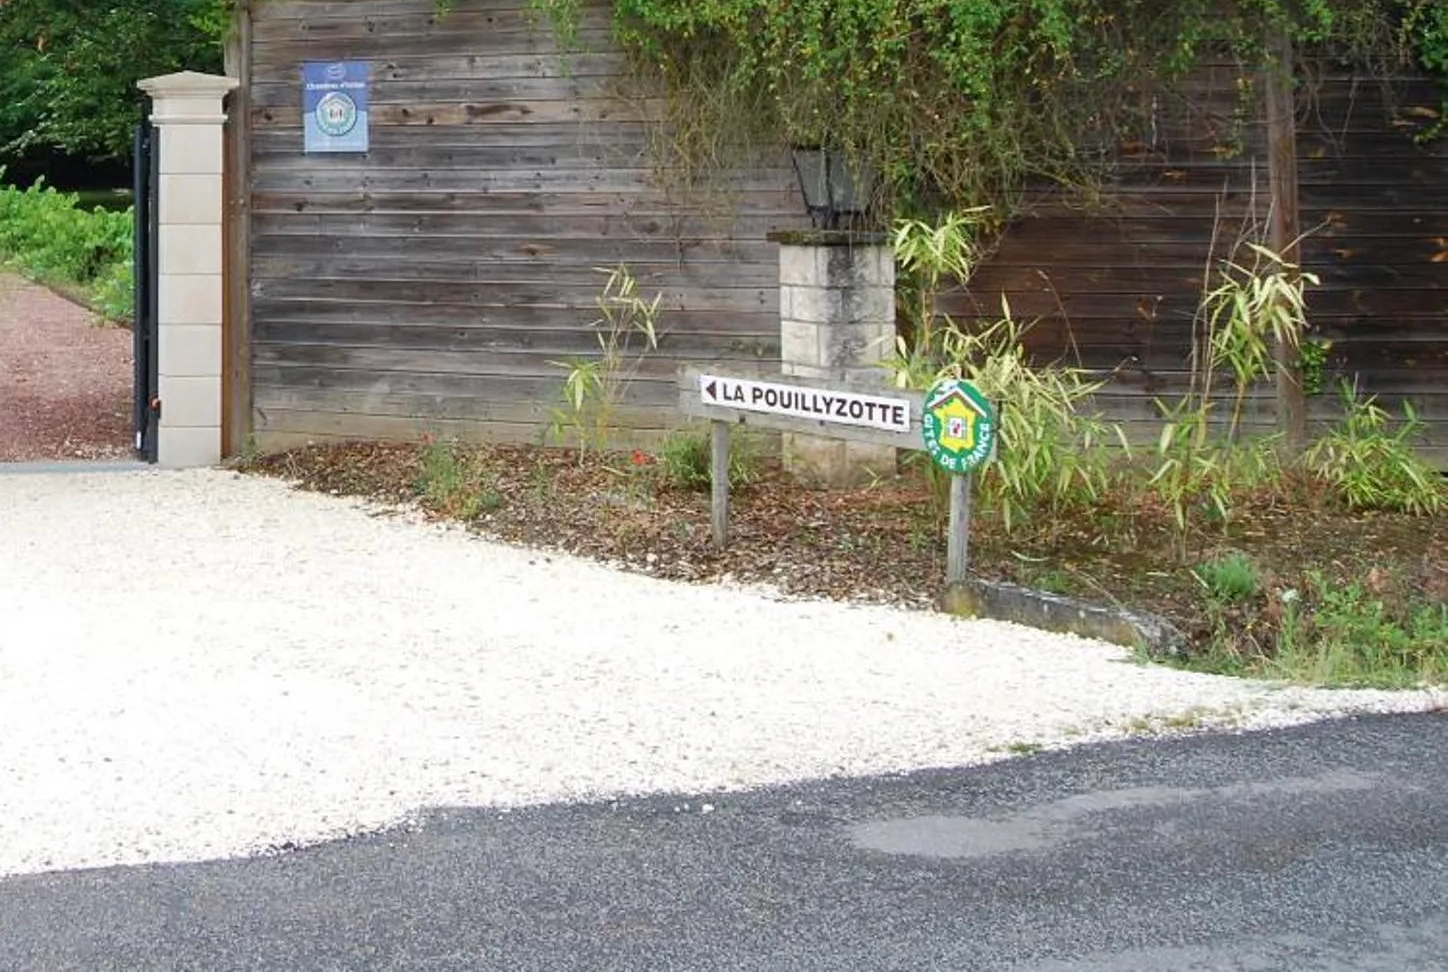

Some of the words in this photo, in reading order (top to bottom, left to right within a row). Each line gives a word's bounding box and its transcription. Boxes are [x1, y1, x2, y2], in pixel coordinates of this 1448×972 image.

[722, 383, 745, 403] LA
[752, 387, 905, 425] POUILLYZOTTE
[940, 453, 957, 469] DE
[960, 423, 990, 471] FRANCE
